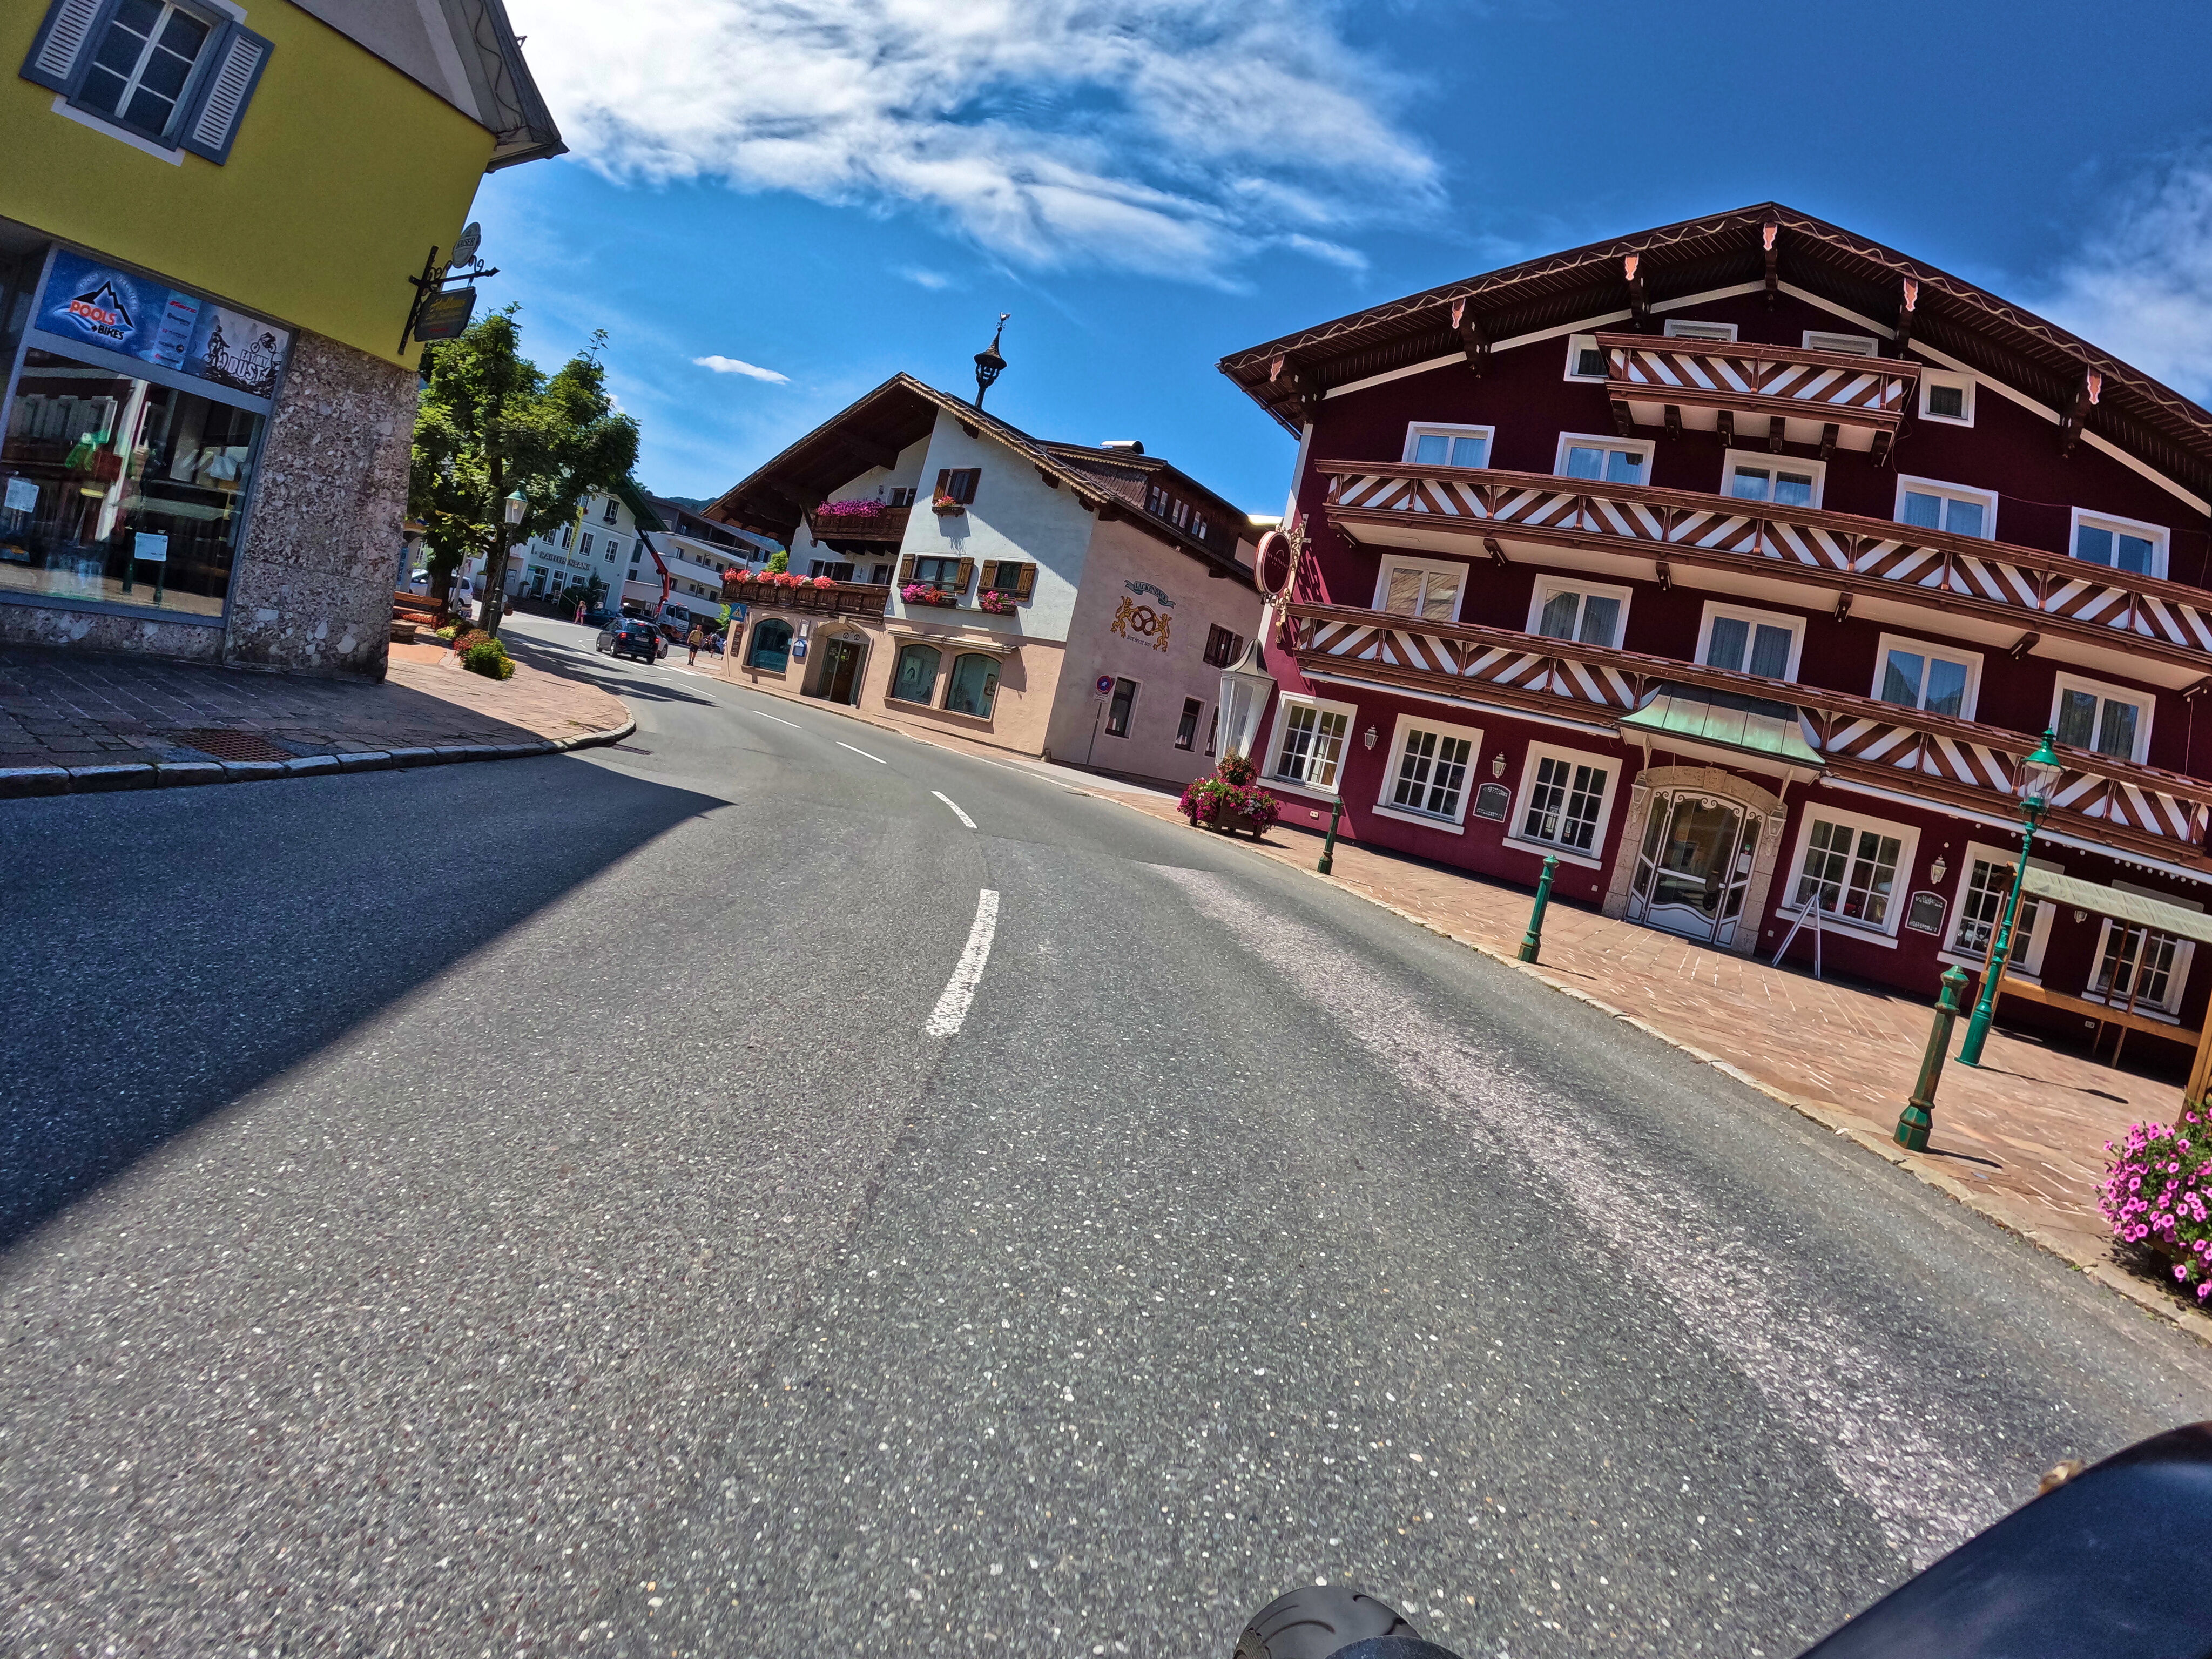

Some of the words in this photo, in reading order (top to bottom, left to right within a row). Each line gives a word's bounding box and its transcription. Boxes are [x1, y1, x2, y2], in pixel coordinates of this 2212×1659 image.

[456, 237, 475, 249] KAISER
[70, 301, 117, 326] POOLS
[240, 349, 256, 364] EAT
[227, 356, 265, 383] DUST
[539, 551, 591, 571] RAIFFEISNBANK
